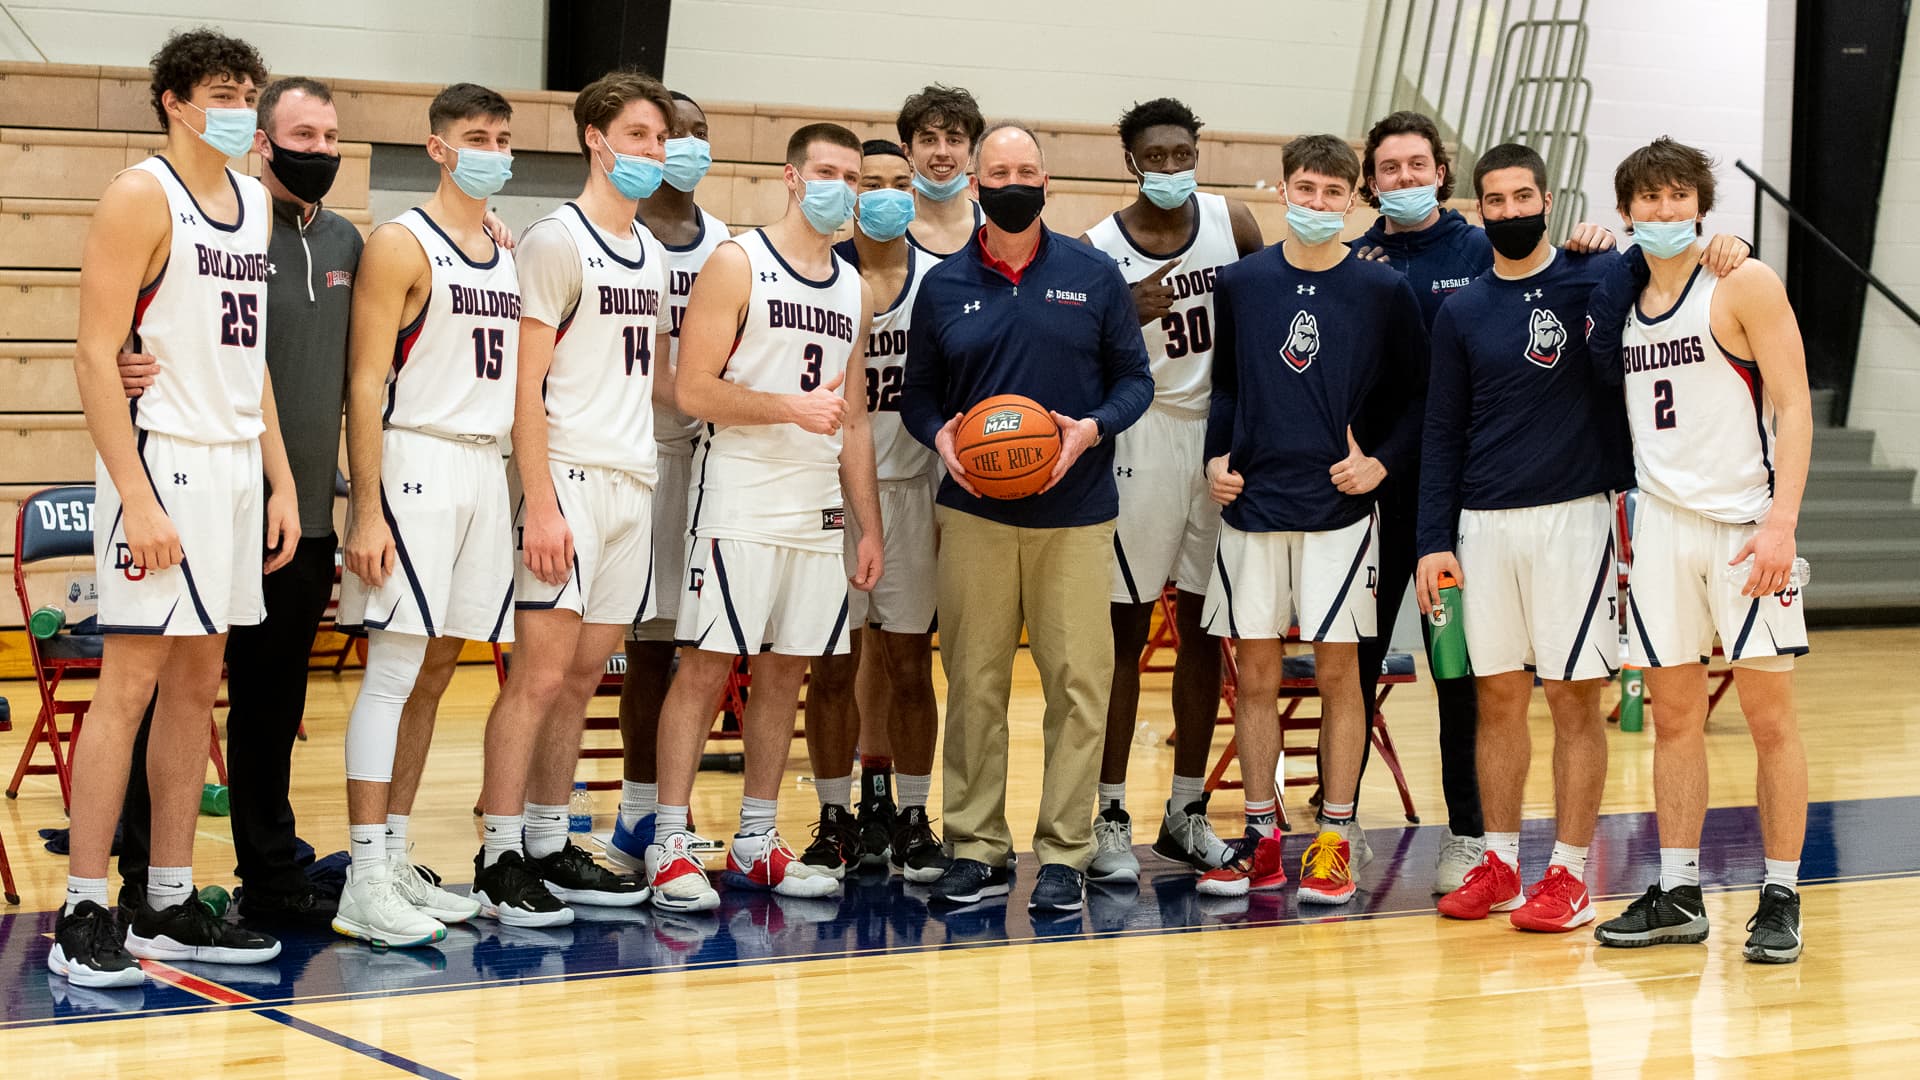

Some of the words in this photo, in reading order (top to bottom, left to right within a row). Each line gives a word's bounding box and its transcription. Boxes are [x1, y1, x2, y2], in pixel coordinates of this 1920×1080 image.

[448, 284, 521, 322] BULLDOGS
[1056, 290, 1087, 302] DESALES
[1441, 277, 1470, 289] DESALES
[221, 291, 257, 348] 25
[767, 299, 853, 344] BULLDOGS
[1161, 306, 1213, 359] 30
[472, 327, 504, 380] 15
[622, 326, 651, 376] 14
[800, 343, 824, 393] 3
[1623, 335, 1705, 375] BULLDOGS
[1654, 379, 1676, 430] 2
[985, 419, 1019, 434] MAC
[973, 451, 1002, 472] THE
[1007, 447, 1044, 470] ROCK
[1627, 680, 1641, 697] G
